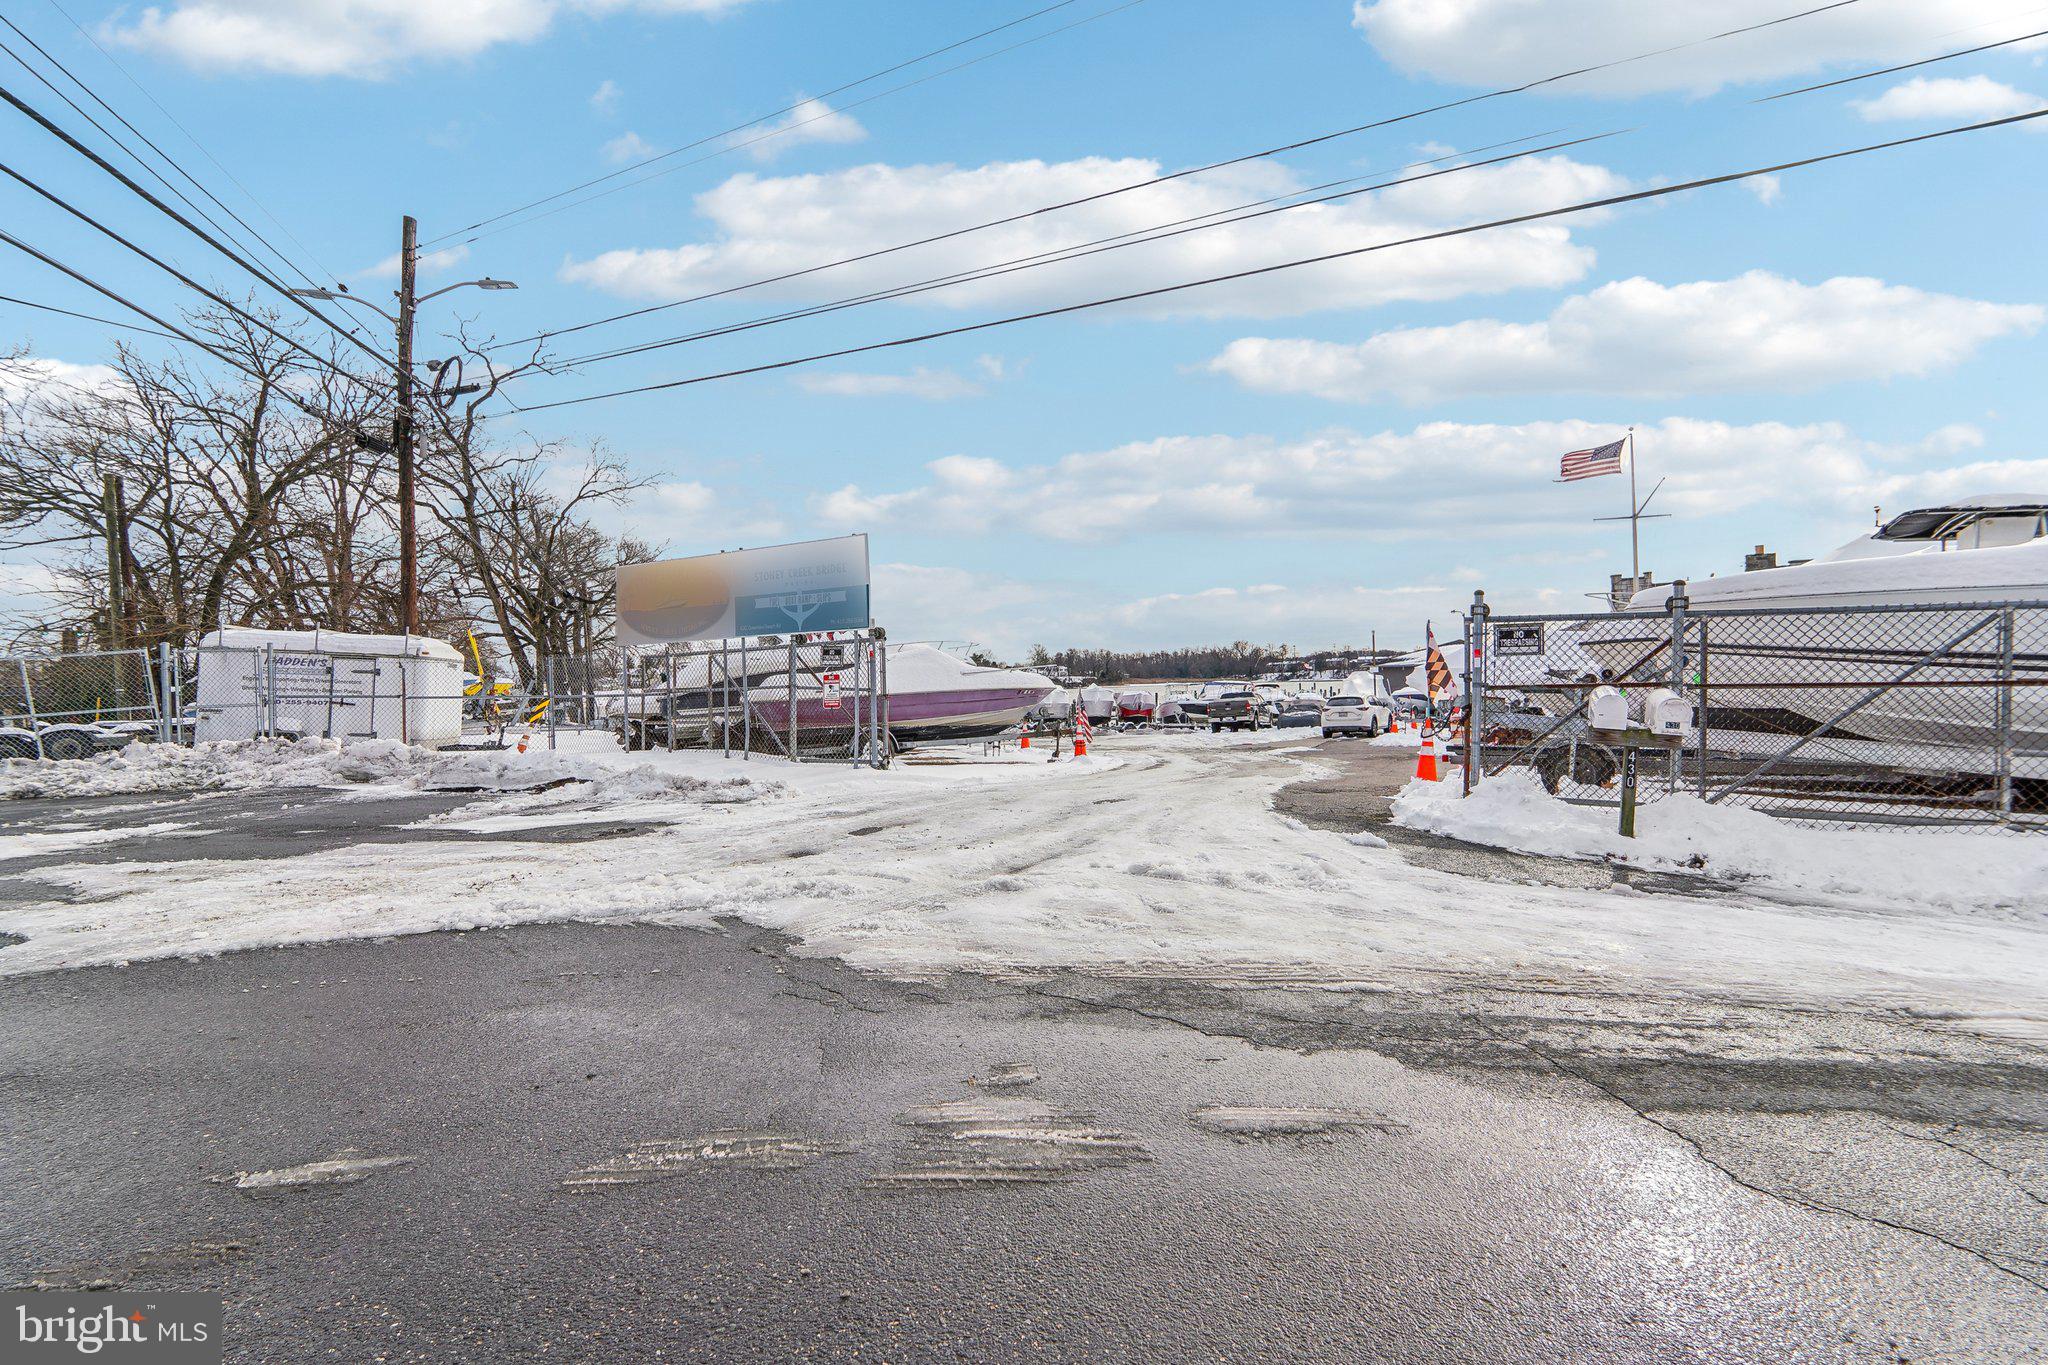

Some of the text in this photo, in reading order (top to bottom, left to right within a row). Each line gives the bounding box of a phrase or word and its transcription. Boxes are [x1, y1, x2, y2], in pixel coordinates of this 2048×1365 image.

[788, 566, 814, 578] CREEK
[816, 561, 848, 576] BRIDGE
[1513, 630, 1525, 639] NO
[1499, 638, 1539, 647] TRESPASSING
[1626, 751, 1636, 788] 430
